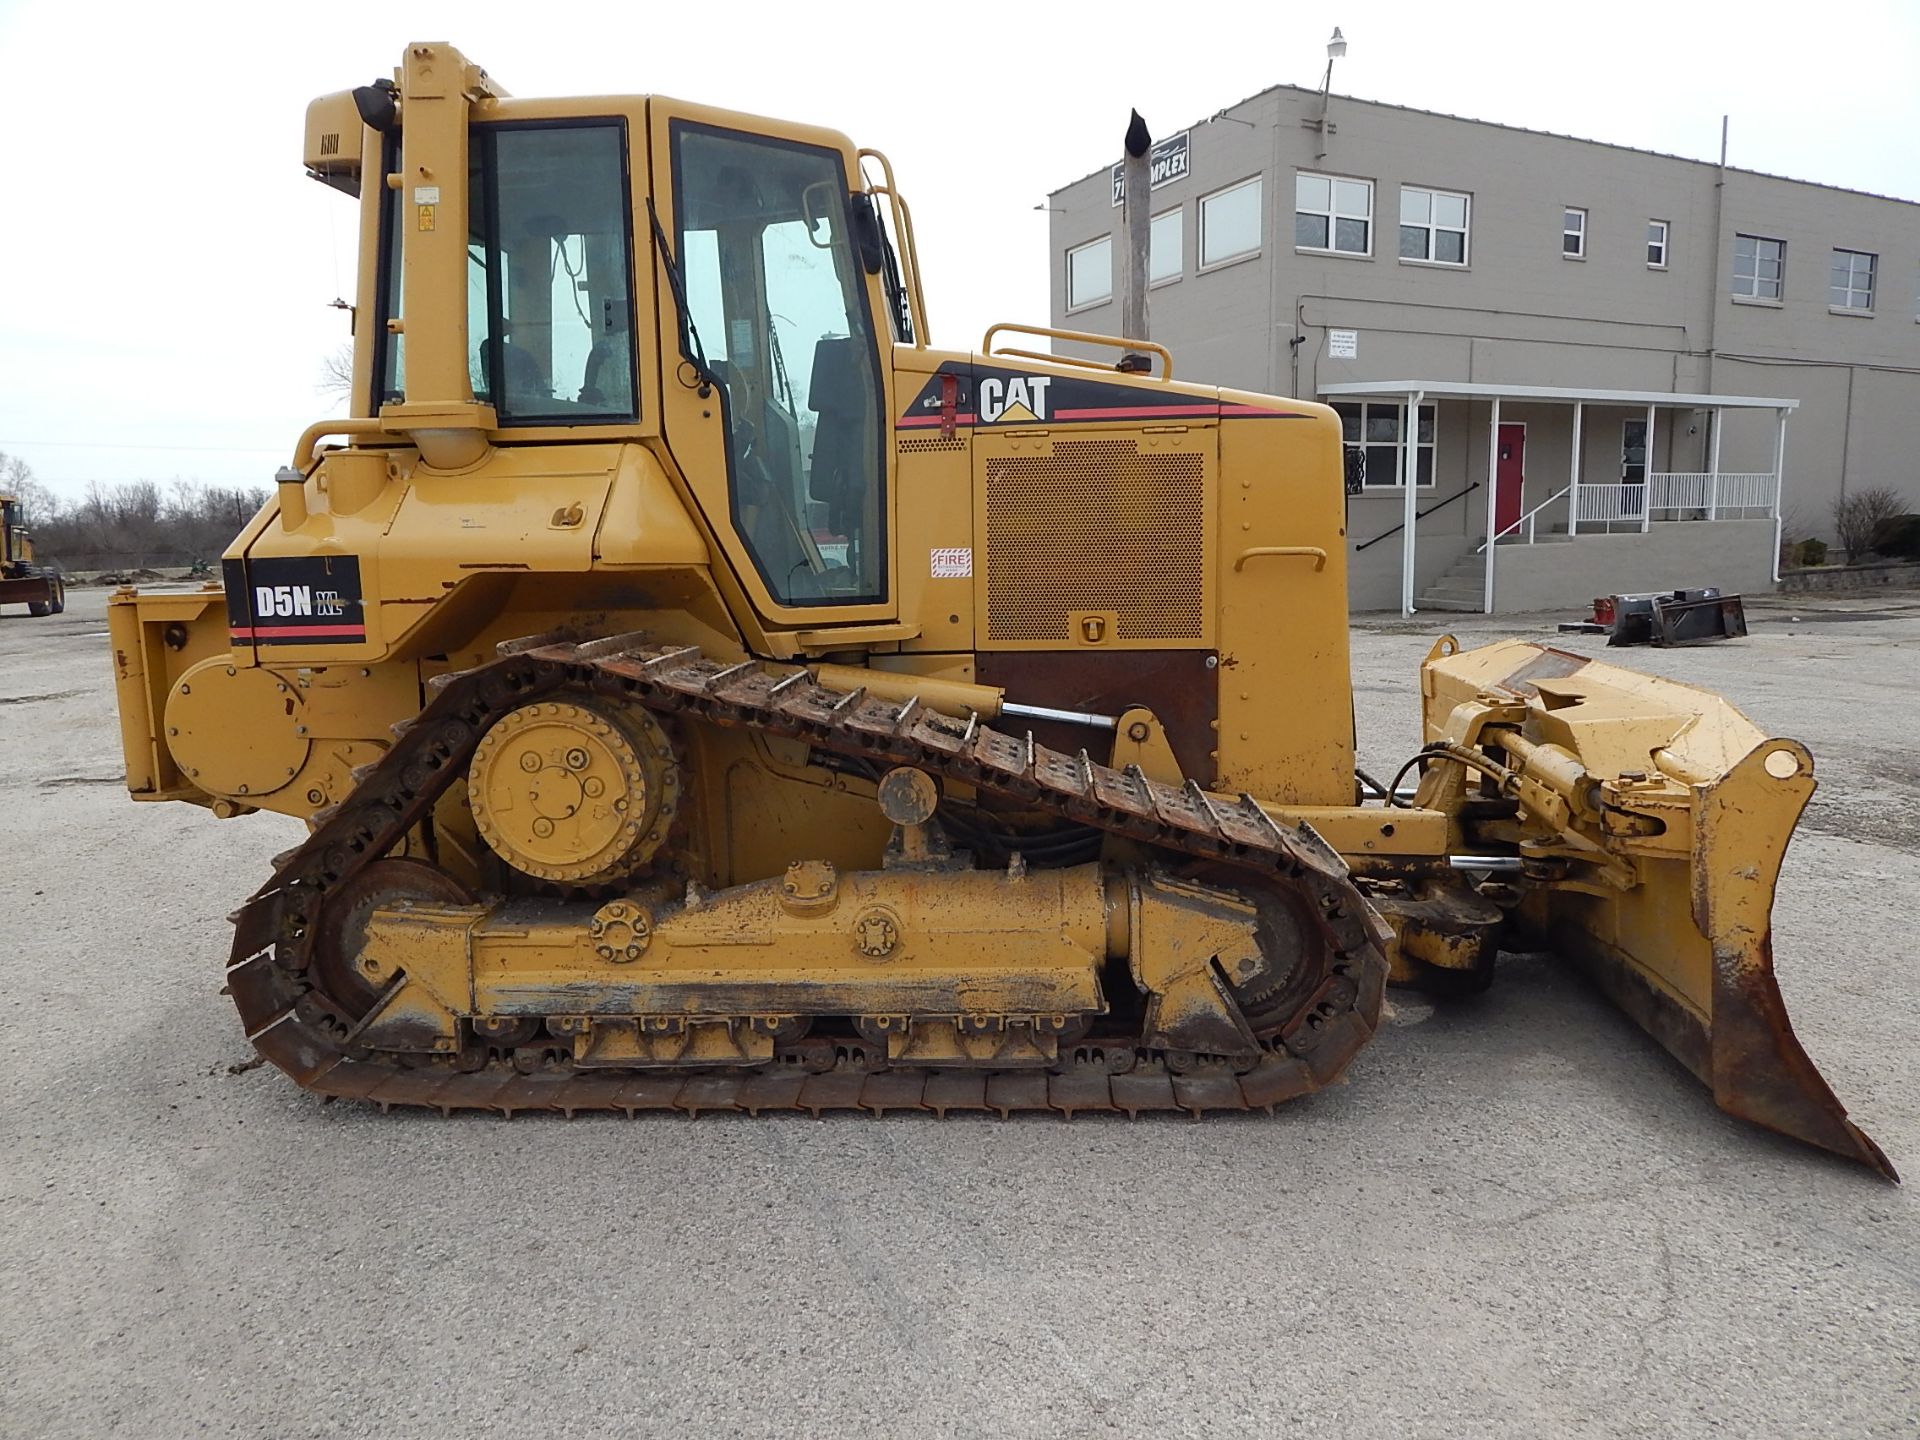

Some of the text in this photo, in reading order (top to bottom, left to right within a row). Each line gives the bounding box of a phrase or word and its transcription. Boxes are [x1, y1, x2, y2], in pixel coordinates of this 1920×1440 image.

[1151, 152, 1187, 184] MPLEX
[980, 376, 1051, 422] CAT
[938, 555, 965, 565] FIRE
[256, 586, 343, 617] D5N XL
